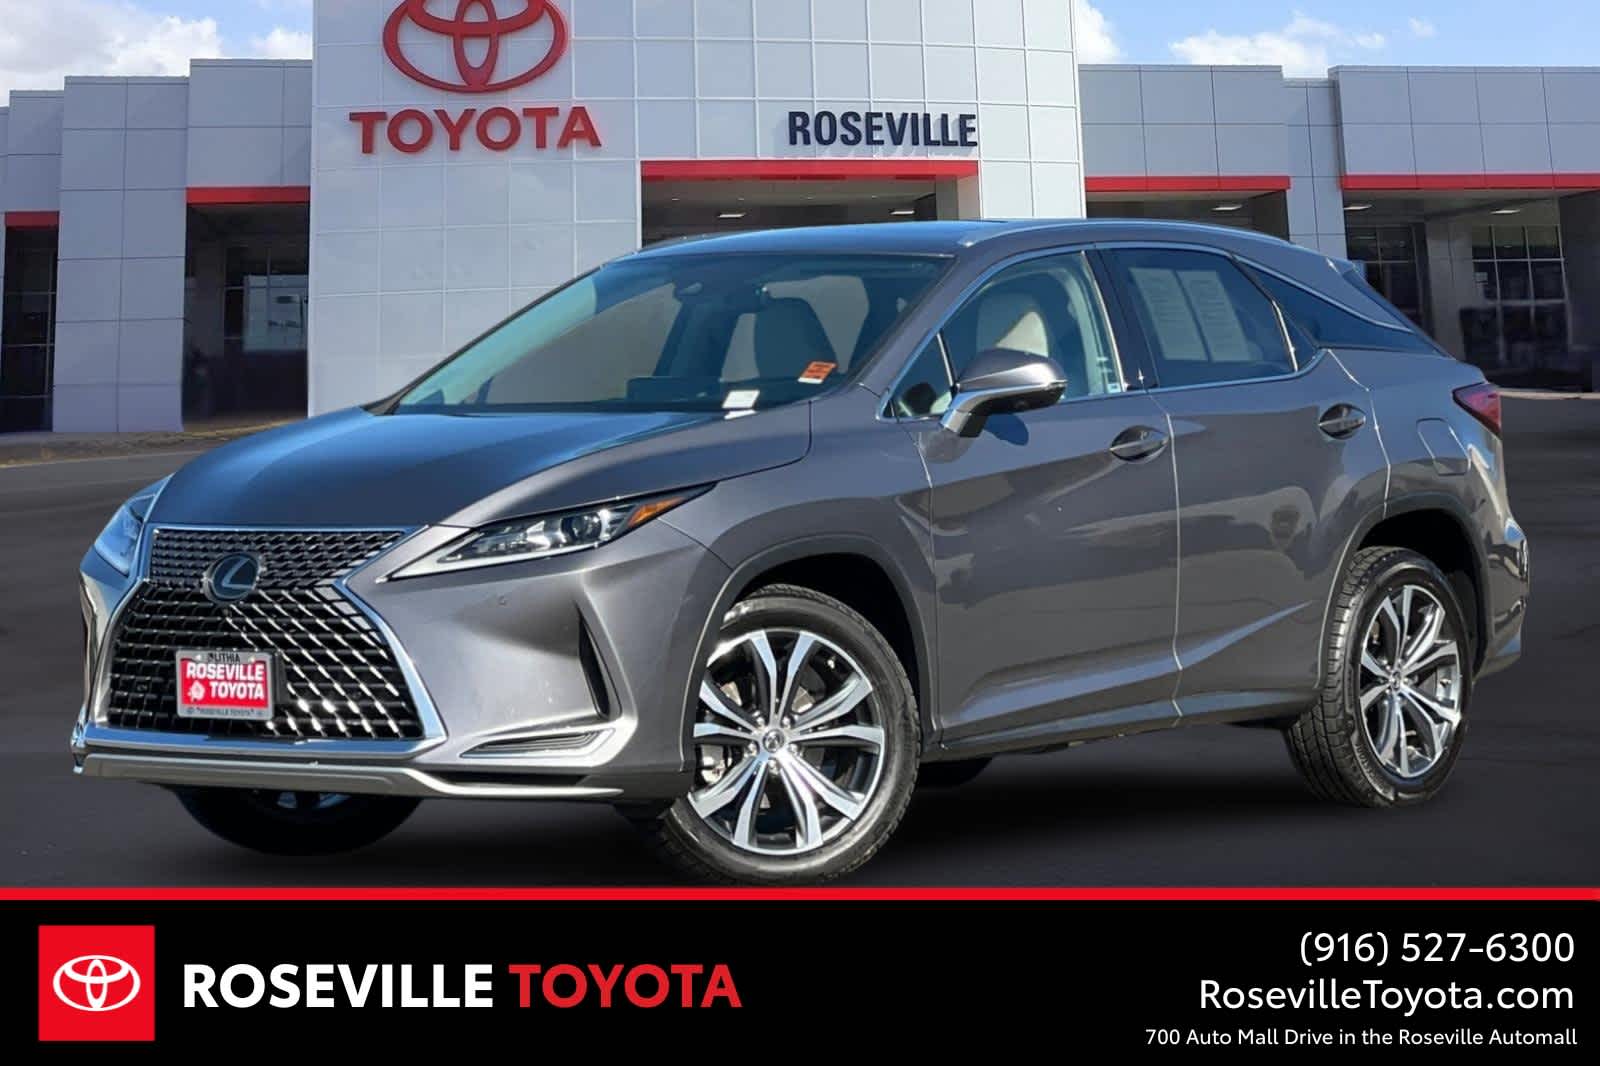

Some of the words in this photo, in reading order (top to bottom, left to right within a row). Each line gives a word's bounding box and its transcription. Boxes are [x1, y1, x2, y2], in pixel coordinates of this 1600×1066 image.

[350, 106, 602, 154] TOYOTA
[788, 110, 978, 148] ROSEVILLE
[186, 662, 264, 680] ROSEVILLE
[209, 681, 264, 700] TOYOTA
